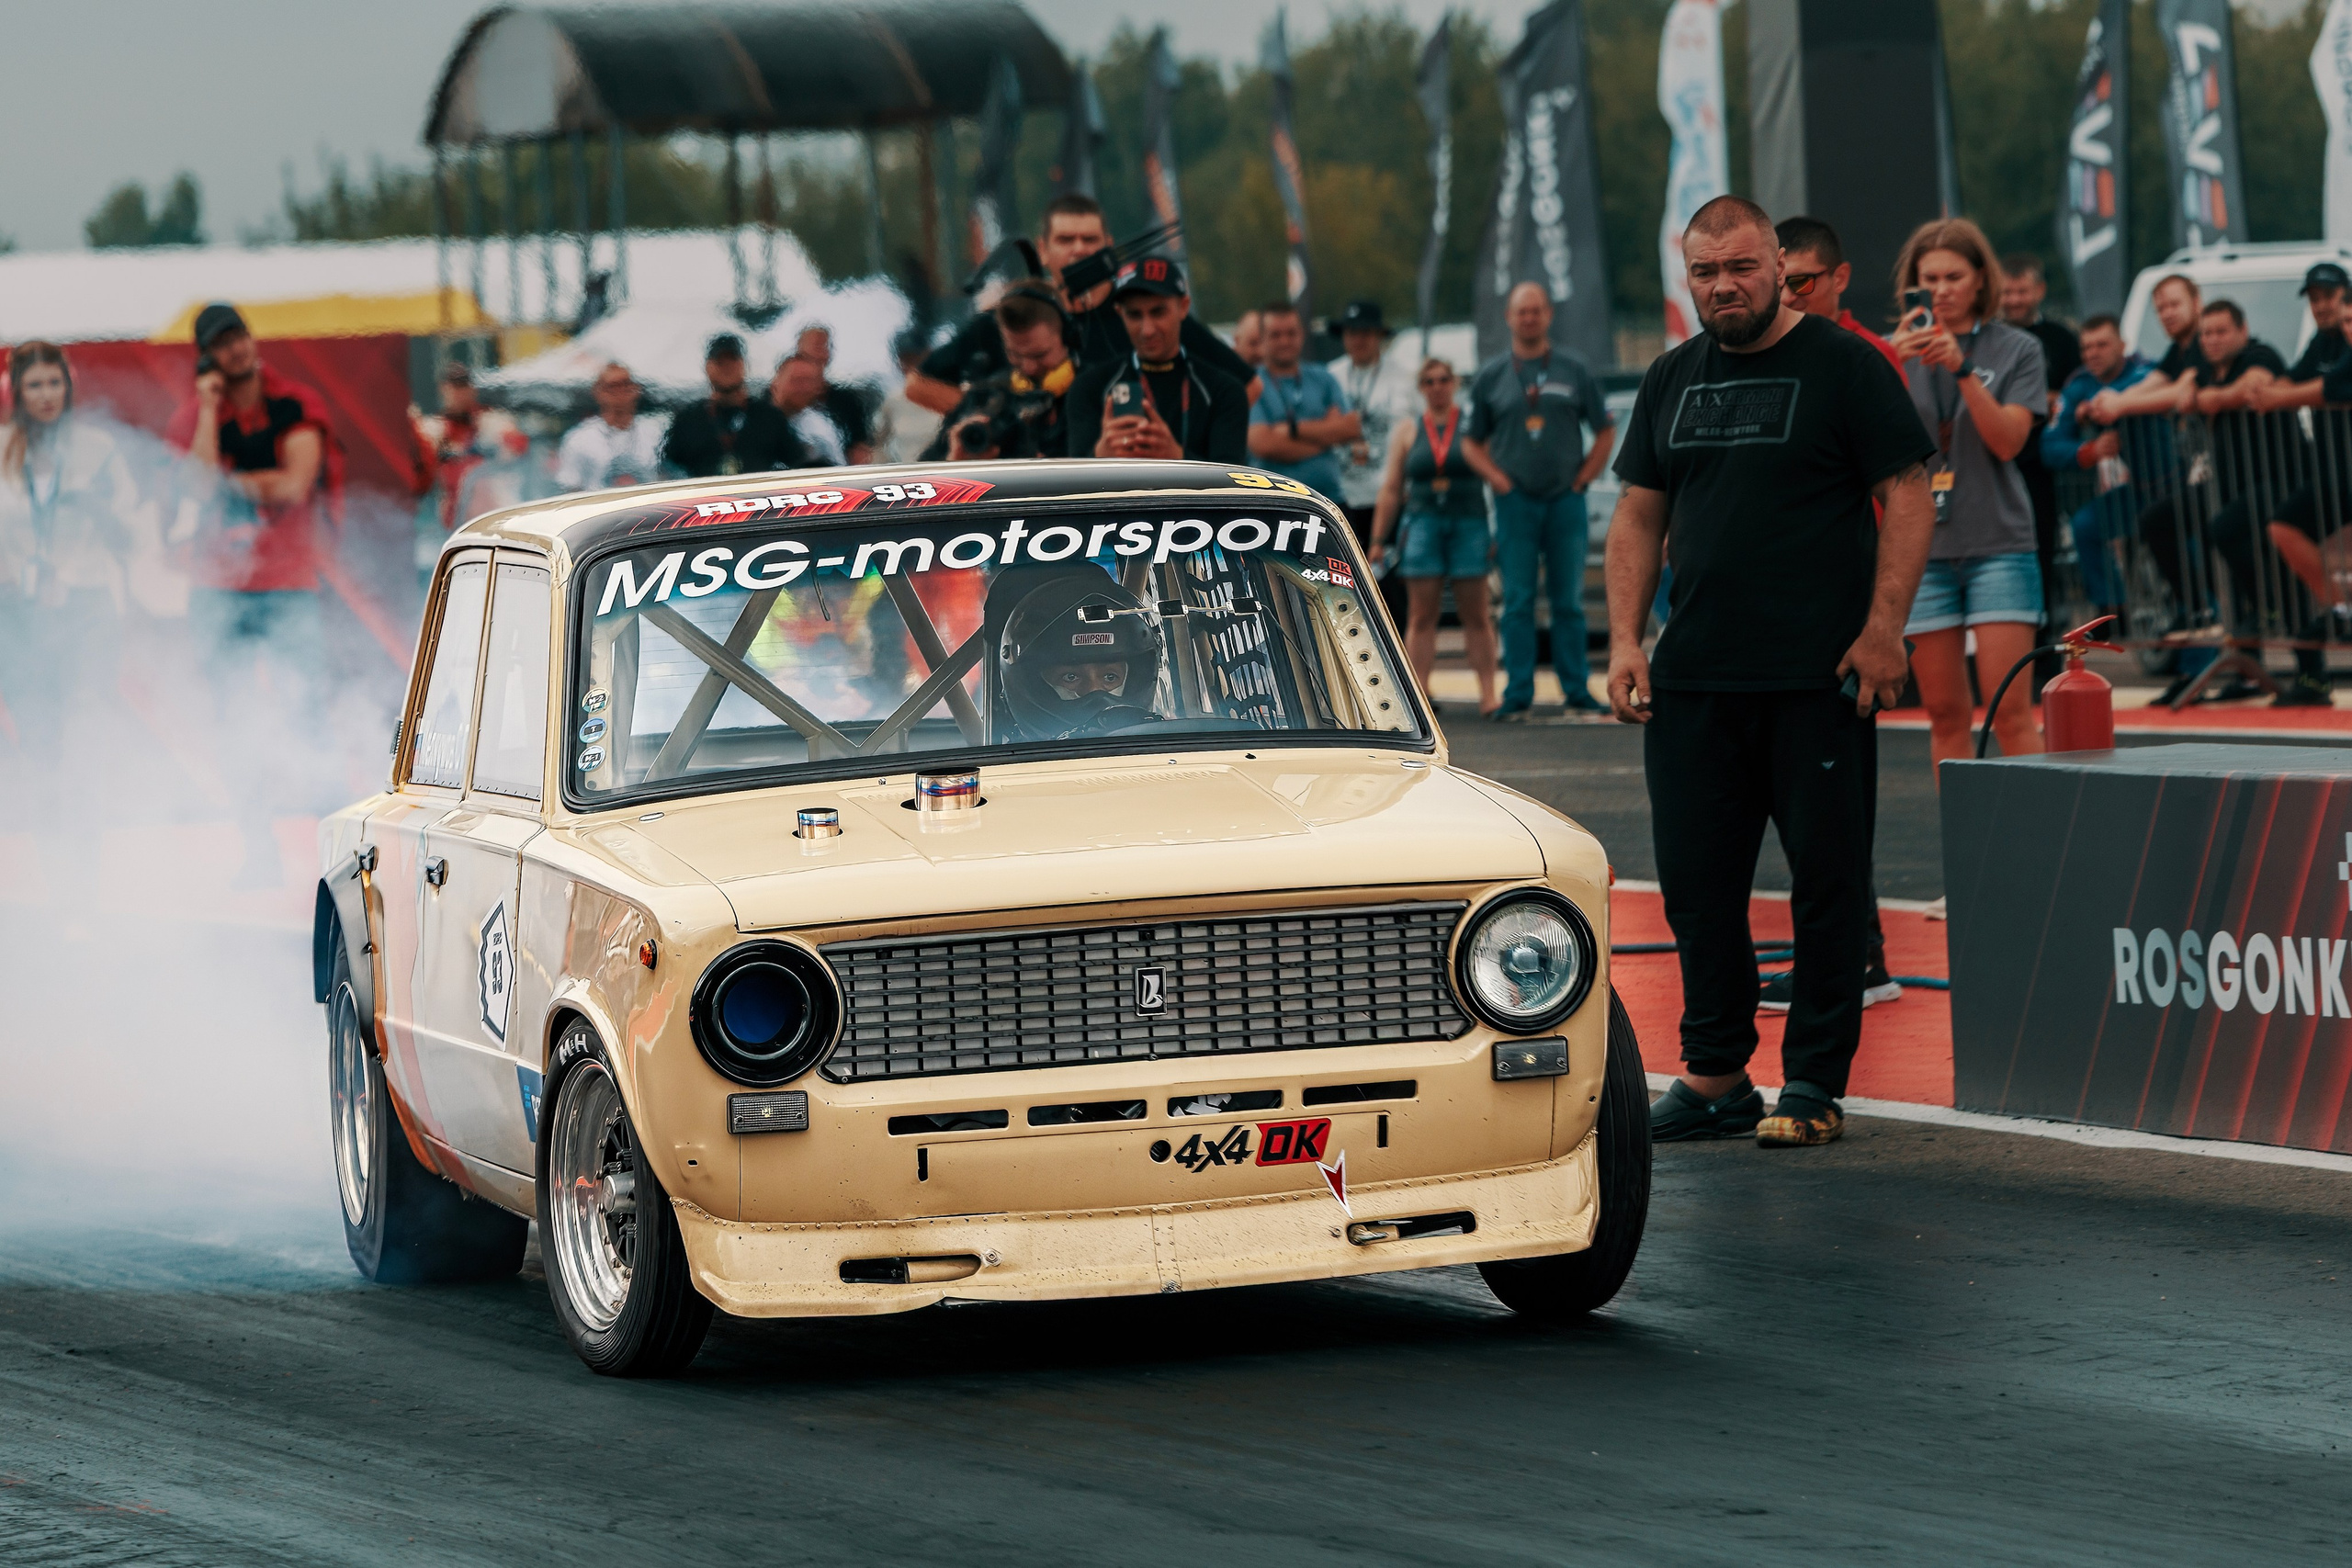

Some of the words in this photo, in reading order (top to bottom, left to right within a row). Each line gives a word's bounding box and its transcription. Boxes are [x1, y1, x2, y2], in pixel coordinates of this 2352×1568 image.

[1682, 404, 1781, 427] EXCHANGE
[1227, 472, 1312, 496] 93
[693, 490, 845, 518] RDRC
[871, 482, 937, 502] 93
[595, 514, 1326, 617] MSG-motorsport
[1331, 572, 1354, 589] OK
[1075, 634, 1110, 644] SIMPSON
[2113, 927, 2352, 1019] ROSGONK
[1260, 1122, 1329, 1163] OK
